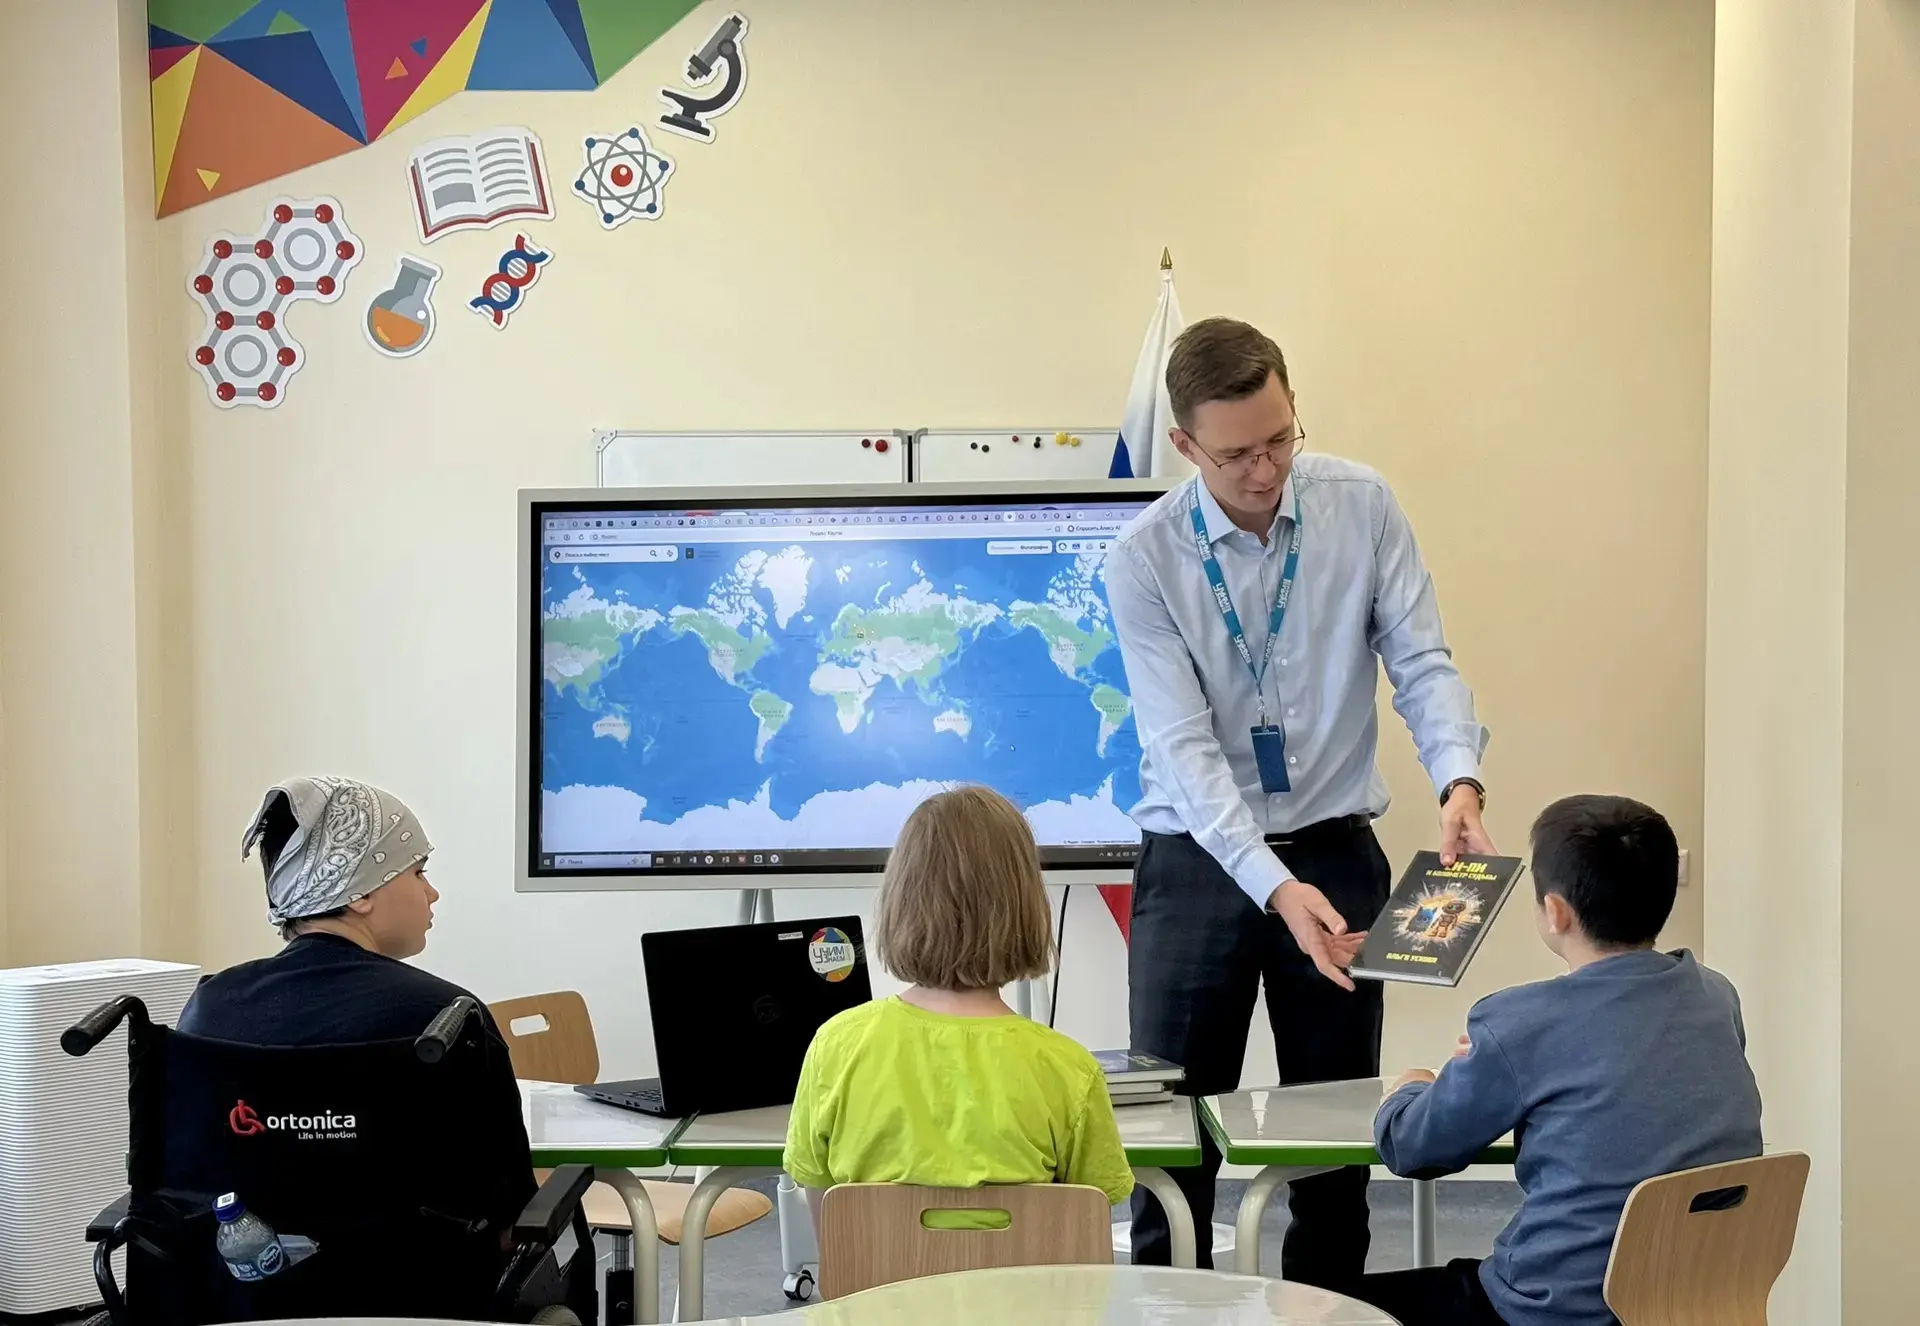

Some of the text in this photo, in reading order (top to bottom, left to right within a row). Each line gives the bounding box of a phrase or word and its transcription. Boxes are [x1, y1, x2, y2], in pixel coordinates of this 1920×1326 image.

[1446, 861, 1488, 873] И-ПИ
[266, 1110, 356, 1130] ortonica
[298, 1131, 357, 1140] Life in motion
